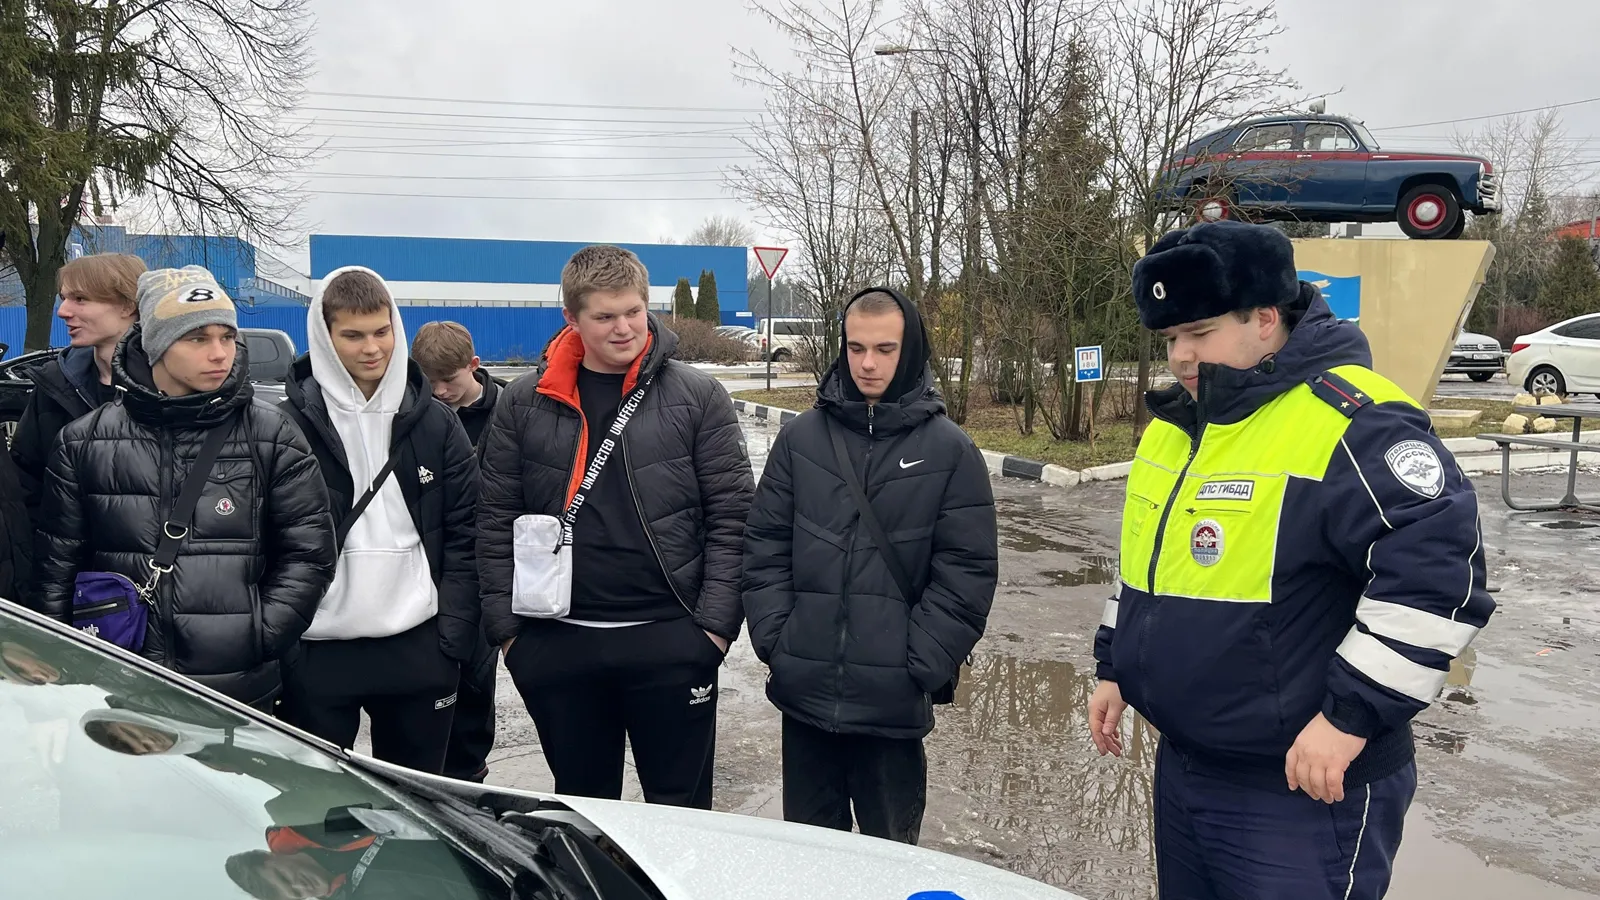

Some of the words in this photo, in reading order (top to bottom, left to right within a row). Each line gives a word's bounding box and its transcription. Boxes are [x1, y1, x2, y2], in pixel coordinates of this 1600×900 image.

[186, 288, 214, 302] 8
[1081, 351, 1096, 360] ПГ
[610, 388, 645, 436] UNAFFECTED
[1389, 442, 1430, 460] ПОЛИЦИЯ
[581, 438, 615, 490] UNAFFECTED
[1397, 450, 1433, 469] РОССИЯ
[1199, 485, 1217, 495] ДПС
[1218, 484, 1249, 496] ГИБДД
[690, 696, 711, 705] adidas
